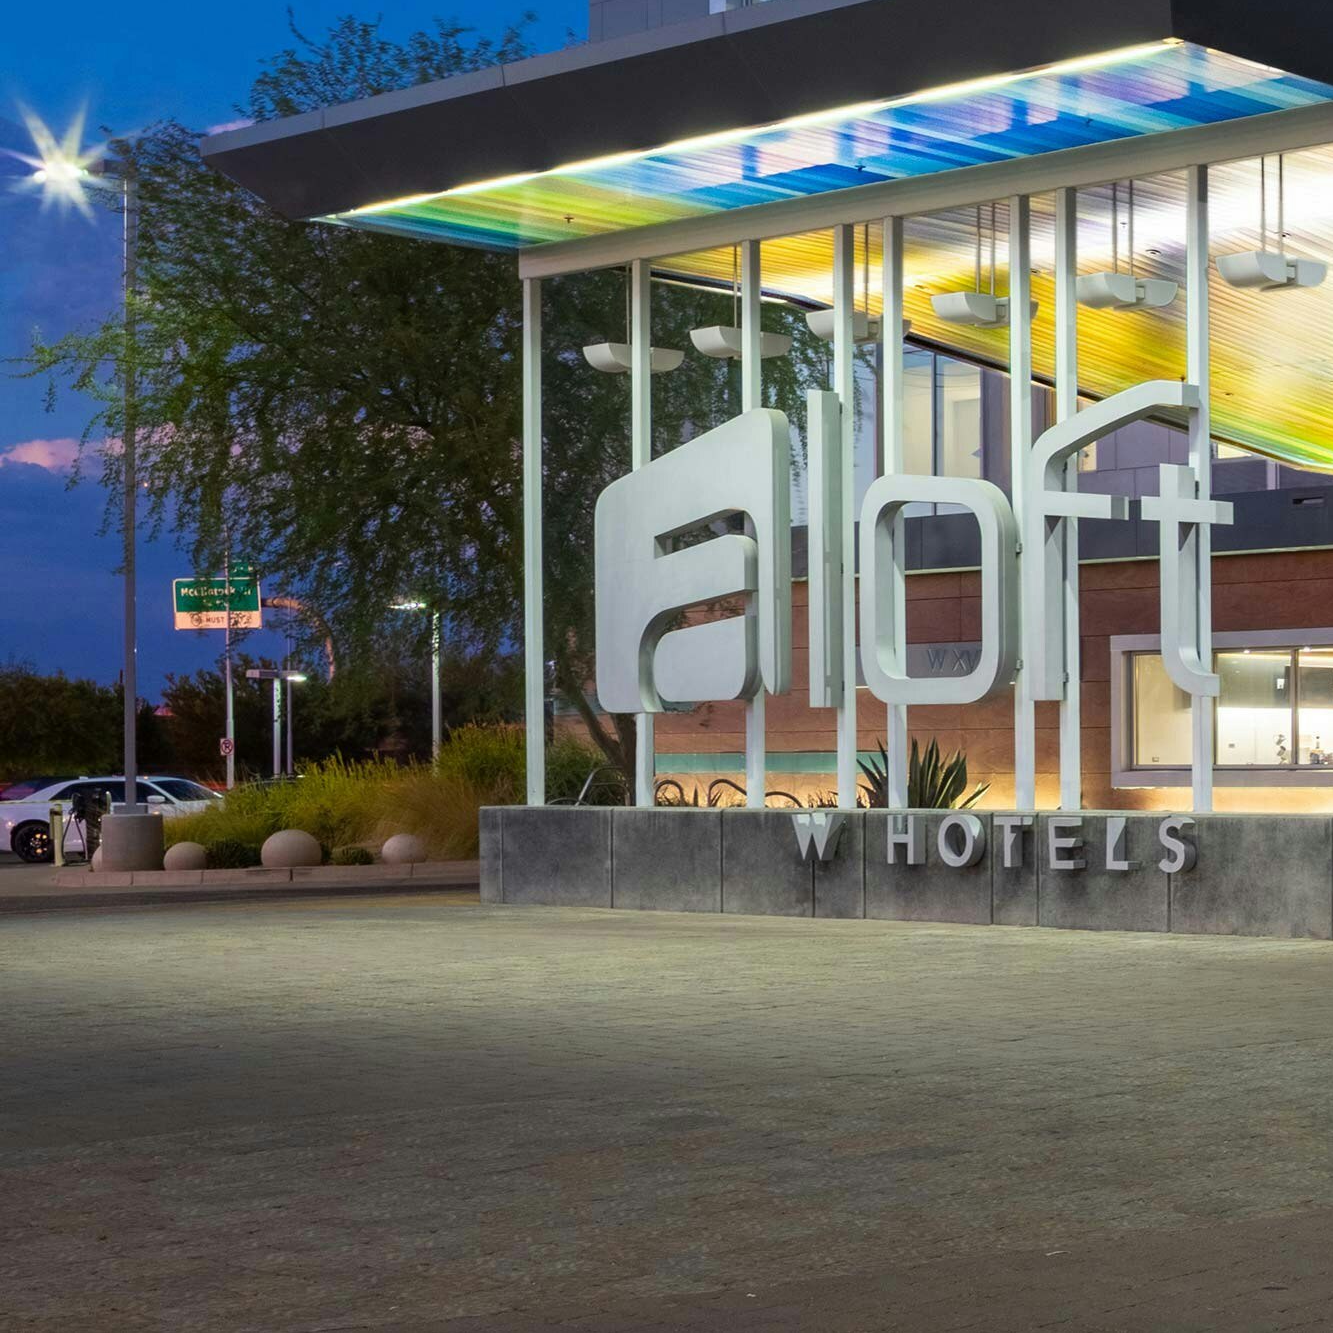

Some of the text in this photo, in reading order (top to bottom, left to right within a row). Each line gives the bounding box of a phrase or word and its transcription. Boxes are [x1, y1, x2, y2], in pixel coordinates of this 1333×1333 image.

[594, 380, 1234, 714] aloft
[205, 616, 225, 625] MUST
[791, 812, 1198, 874] W HOTELS
